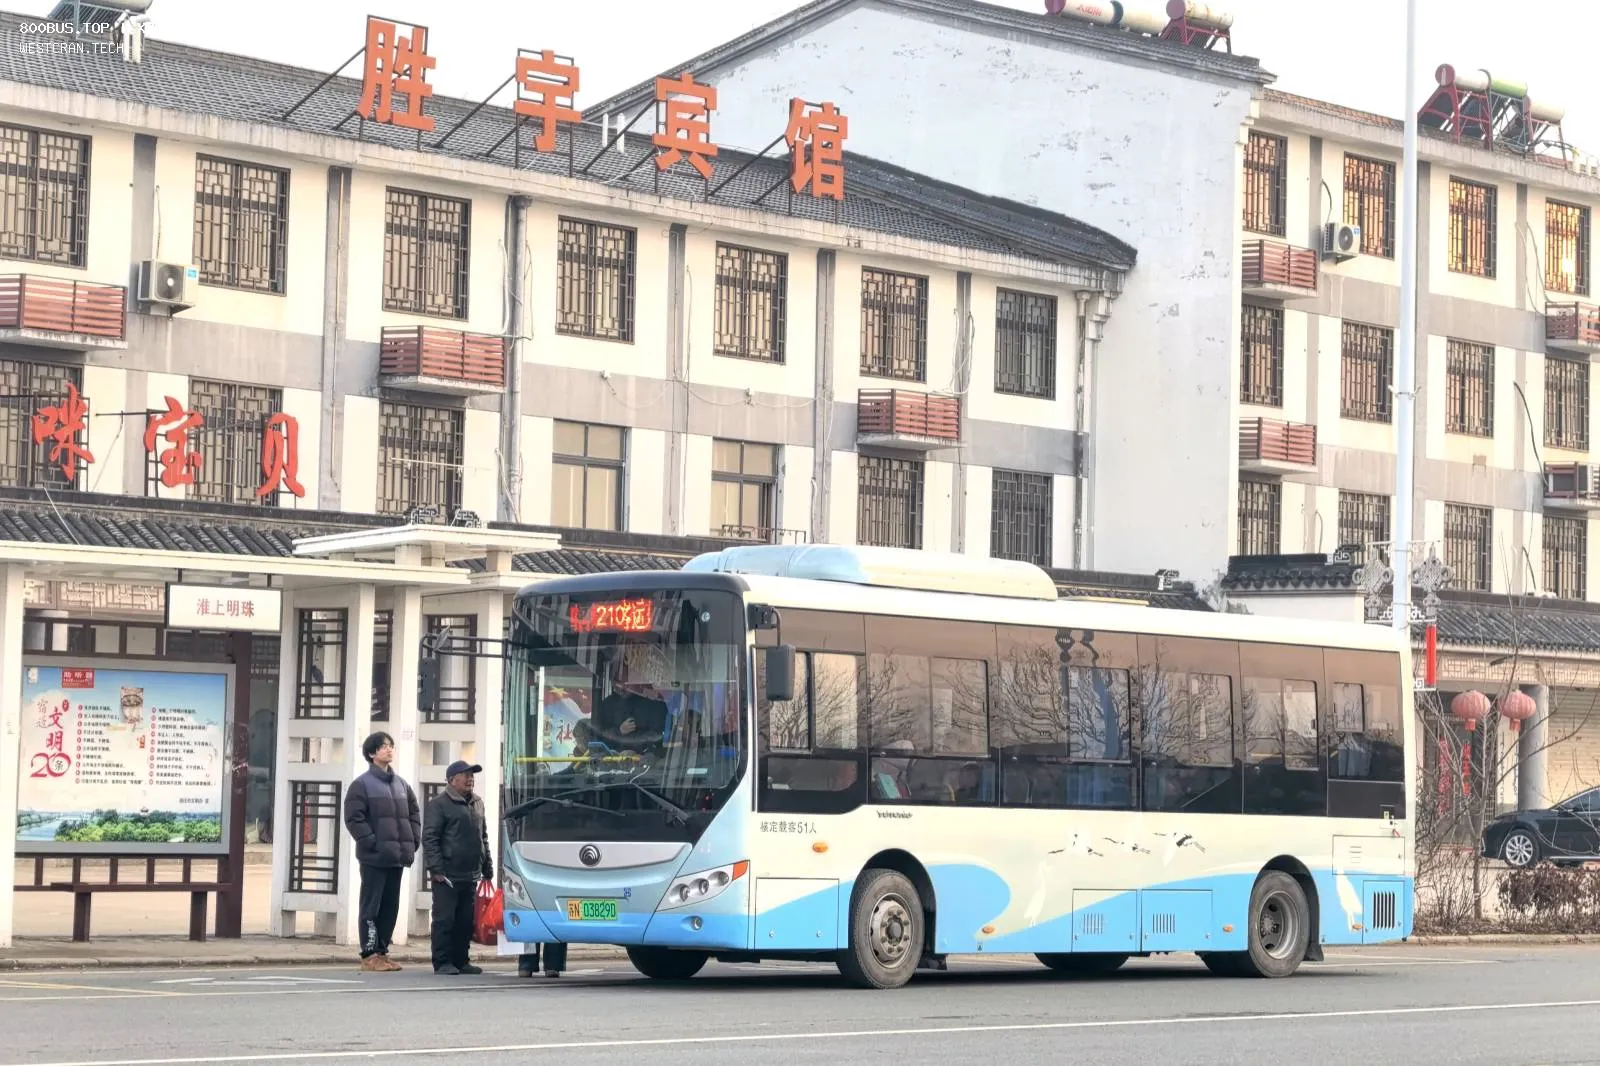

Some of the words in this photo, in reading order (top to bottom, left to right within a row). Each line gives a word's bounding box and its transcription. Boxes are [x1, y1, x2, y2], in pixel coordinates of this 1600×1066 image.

[359, 18, 848, 200] 胜宇宾馆
[196, 598, 255, 618] 淮上明珠
[760, 821, 817, 834] 核定载客51人
